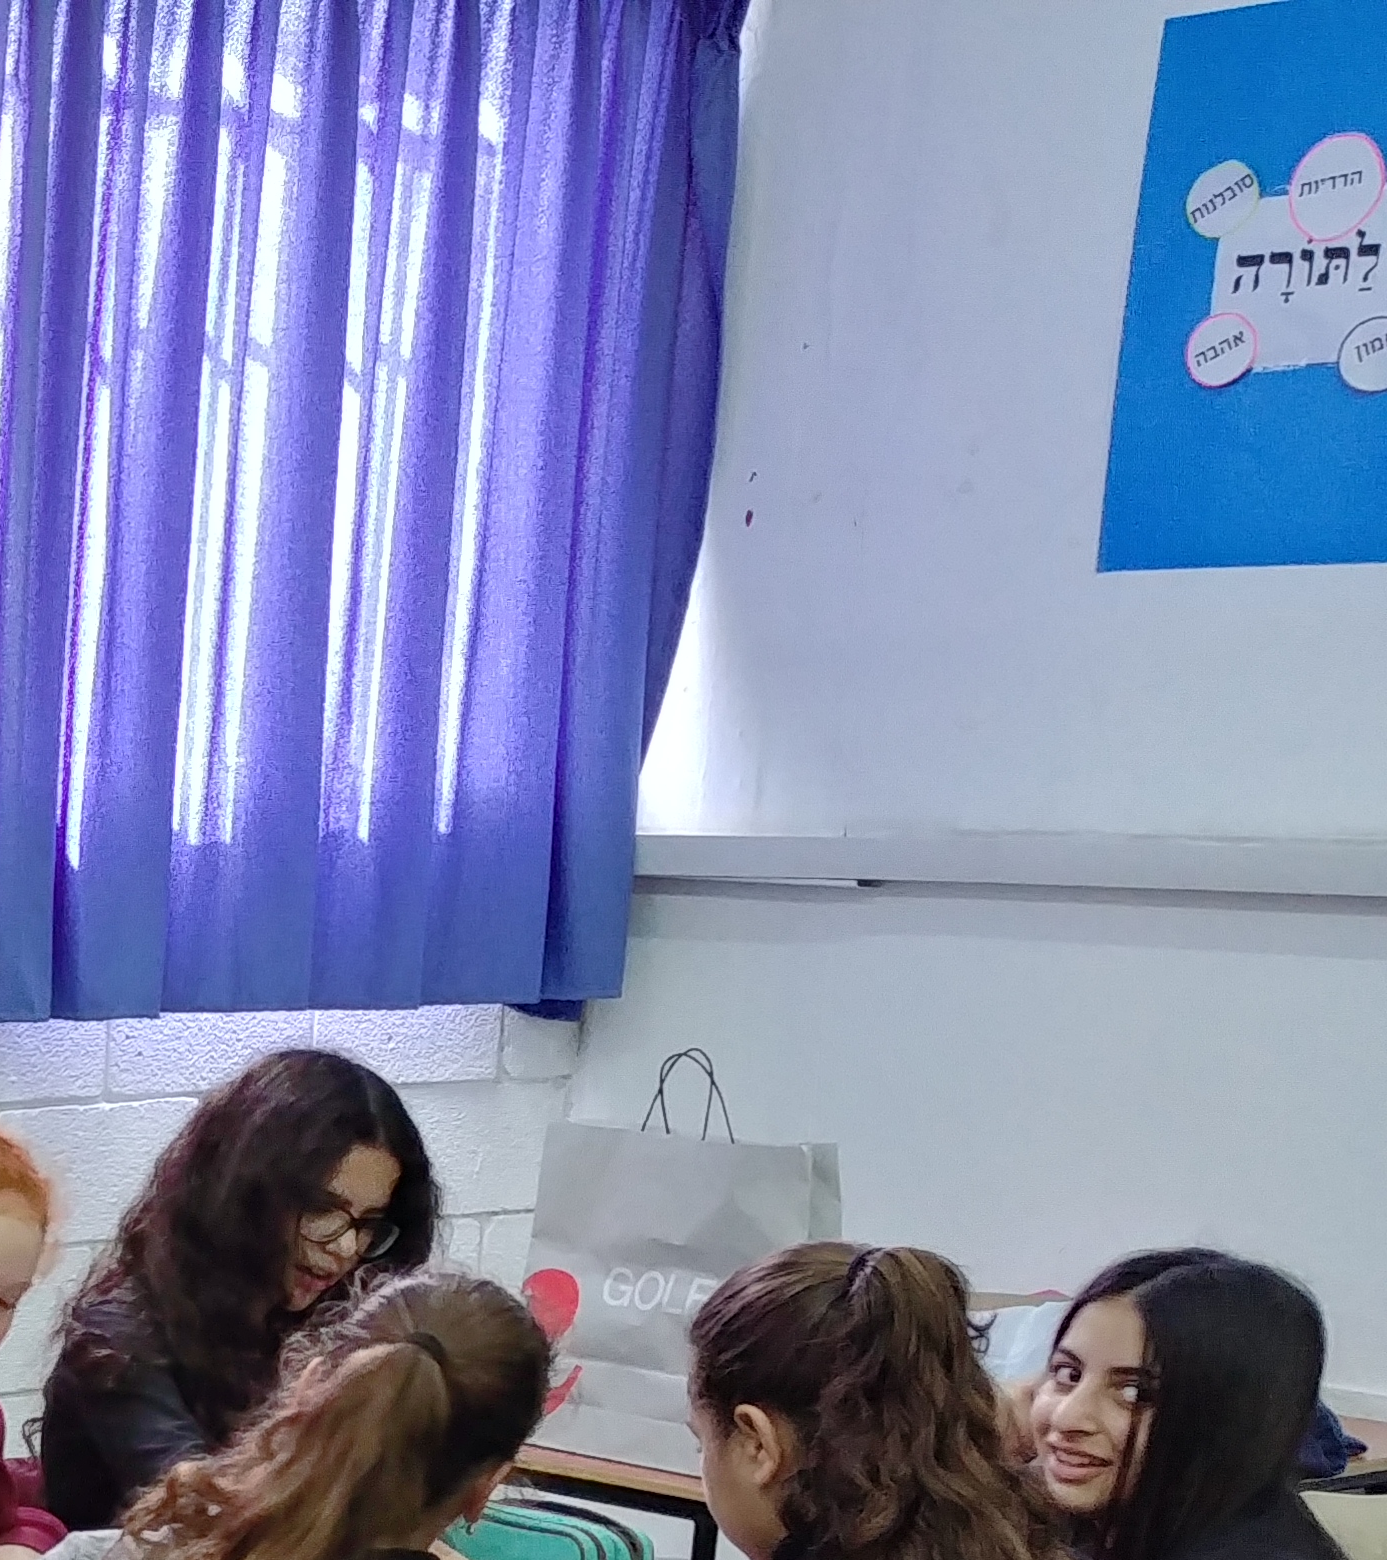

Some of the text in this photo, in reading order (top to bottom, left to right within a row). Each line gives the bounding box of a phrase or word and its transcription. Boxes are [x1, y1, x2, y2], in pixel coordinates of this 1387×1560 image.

[1190, 174, 1255, 224] סובלנות
[1298, 170, 1363, 198] הדדיות
[1194, 330, 1246, 367] אהבה
[1354, 330, 1387, 363] מון
[603, 1267, 718, 1315] GOLF
